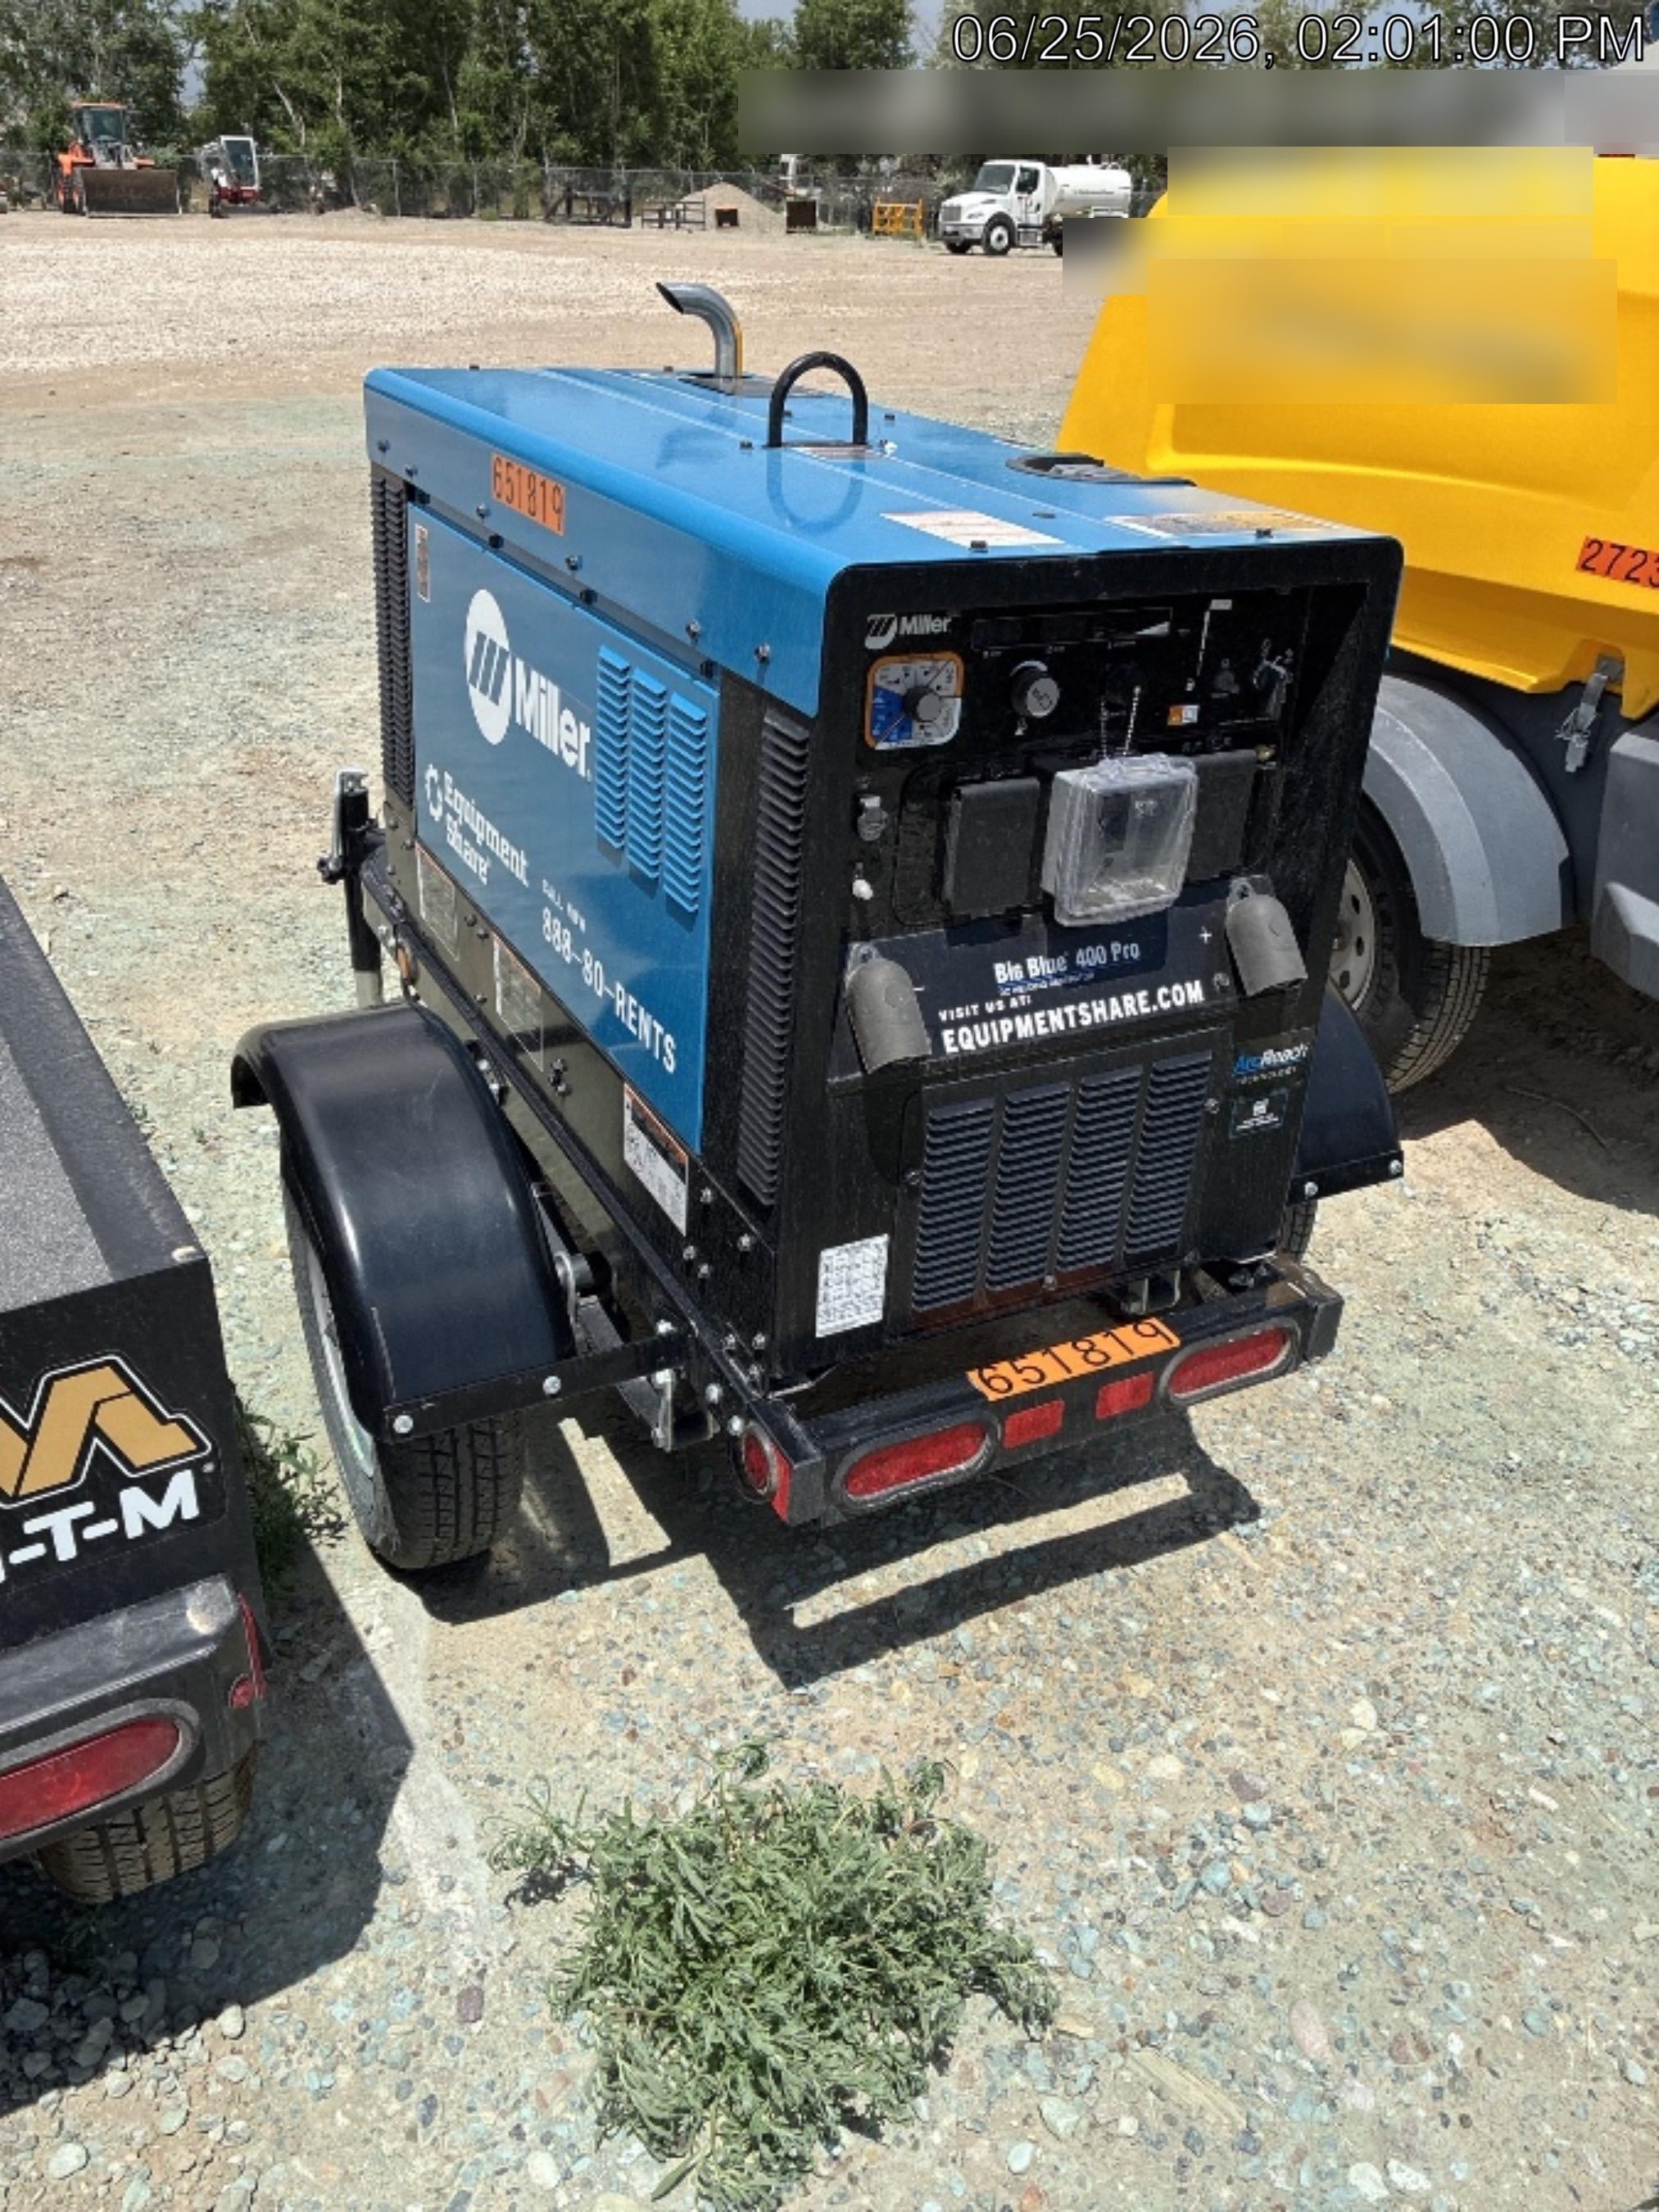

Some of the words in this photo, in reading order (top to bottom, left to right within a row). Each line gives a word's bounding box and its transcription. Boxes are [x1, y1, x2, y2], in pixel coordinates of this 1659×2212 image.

[493, 456, 564, 532] 651819
[900, 614, 952, 635] Miller
[515, 657, 591, 778] Miller
[444, 771, 528, 887] Equipment
[446, 813, 489, 886] Share
[542, 907, 676, 1074] 888-80-RENTS
[1027, 955, 1067, 979] Blue
[1076, 945, 1107, 968] 400
[1111, 941, 1140, 962] Pro
[938, 1003, 979, 1022] VISIT
[985, 999, 1005, 1014] US
[942, 980, 1205, 1054] EQUIPMENTSHARE.COM
[977, 1321, 1173, 1394] 651819
